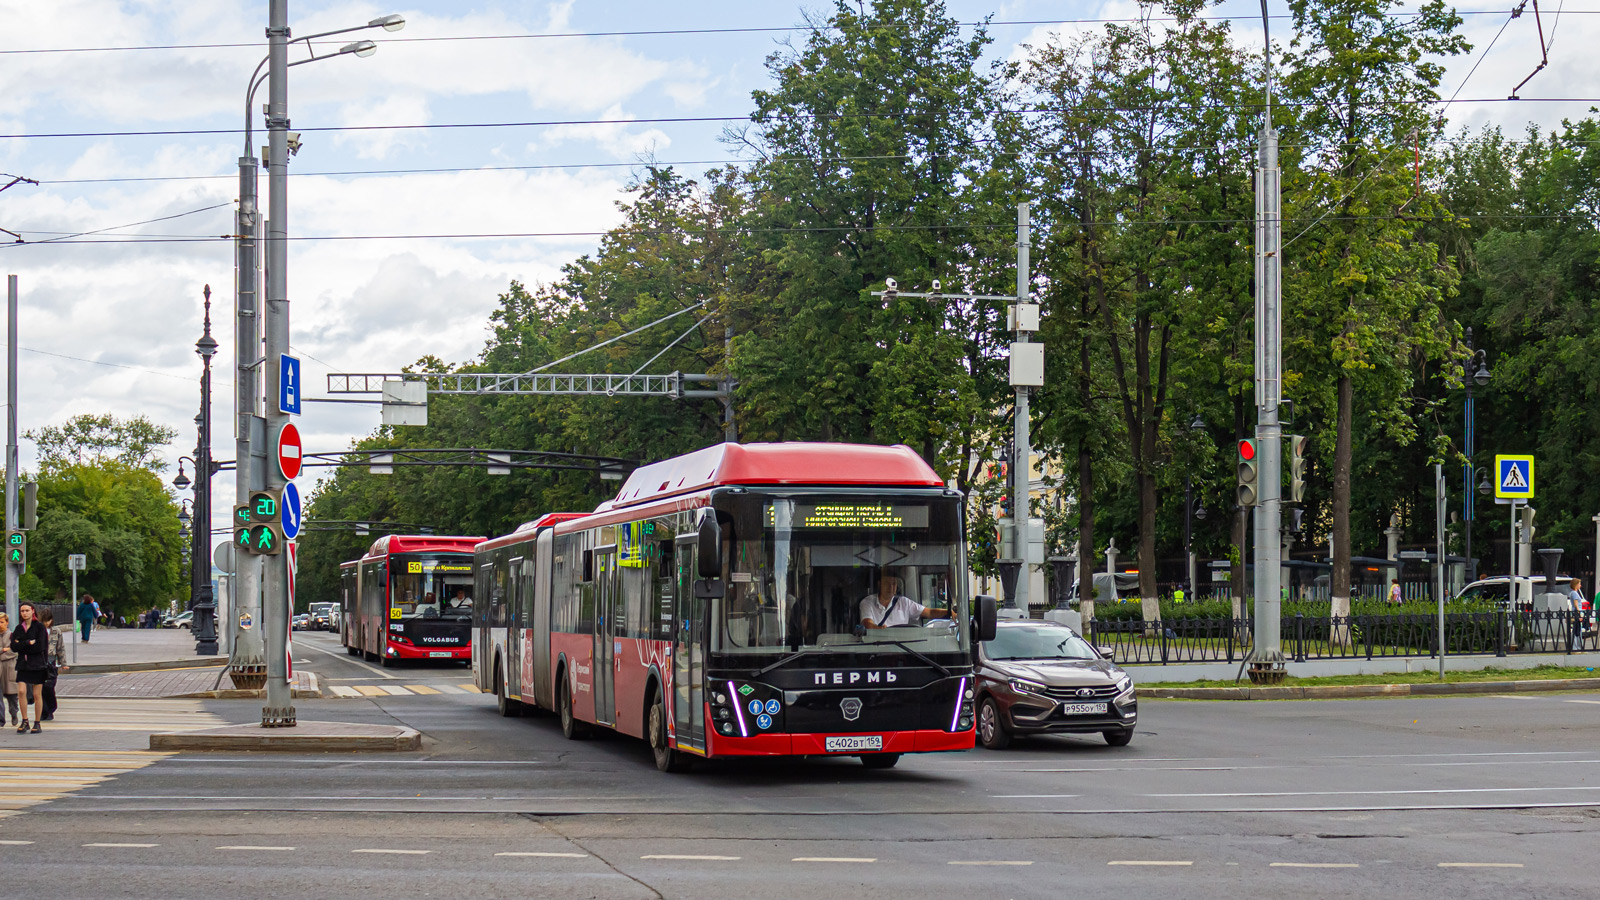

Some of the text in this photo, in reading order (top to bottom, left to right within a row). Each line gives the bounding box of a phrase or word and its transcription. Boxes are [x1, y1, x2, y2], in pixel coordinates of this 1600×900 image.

[257, 498, 275, 515] 20
[11, 535, 22, 544] 20
[409, 563, 420, 571] 50
[814, 671, 897, 684] ПЕРМЬ
[829, 737, 880, 748] С402ВТ 159
